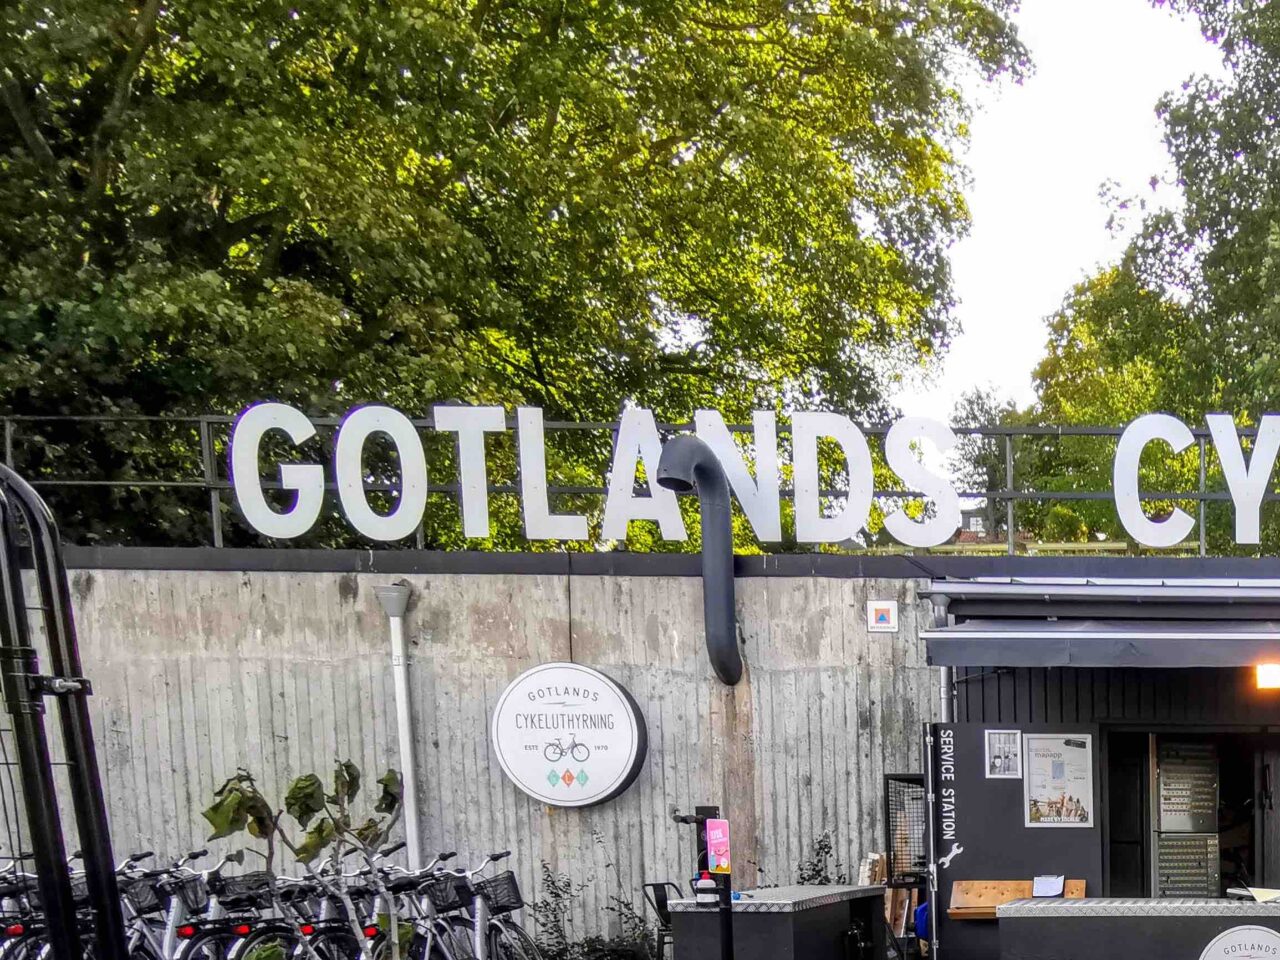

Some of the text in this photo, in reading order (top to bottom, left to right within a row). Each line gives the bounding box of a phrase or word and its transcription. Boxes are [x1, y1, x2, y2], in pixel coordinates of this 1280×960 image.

[231, 401, 962, 547] GOTLANDS
[527, 686, 600, 702] GOTLANDS
[515, 713, 615, 730] CYKELUTHYRNING
[940, 729, 956, 840] SERVICE STATION
[1223, 943, 1278, 955] GOTLANDS
